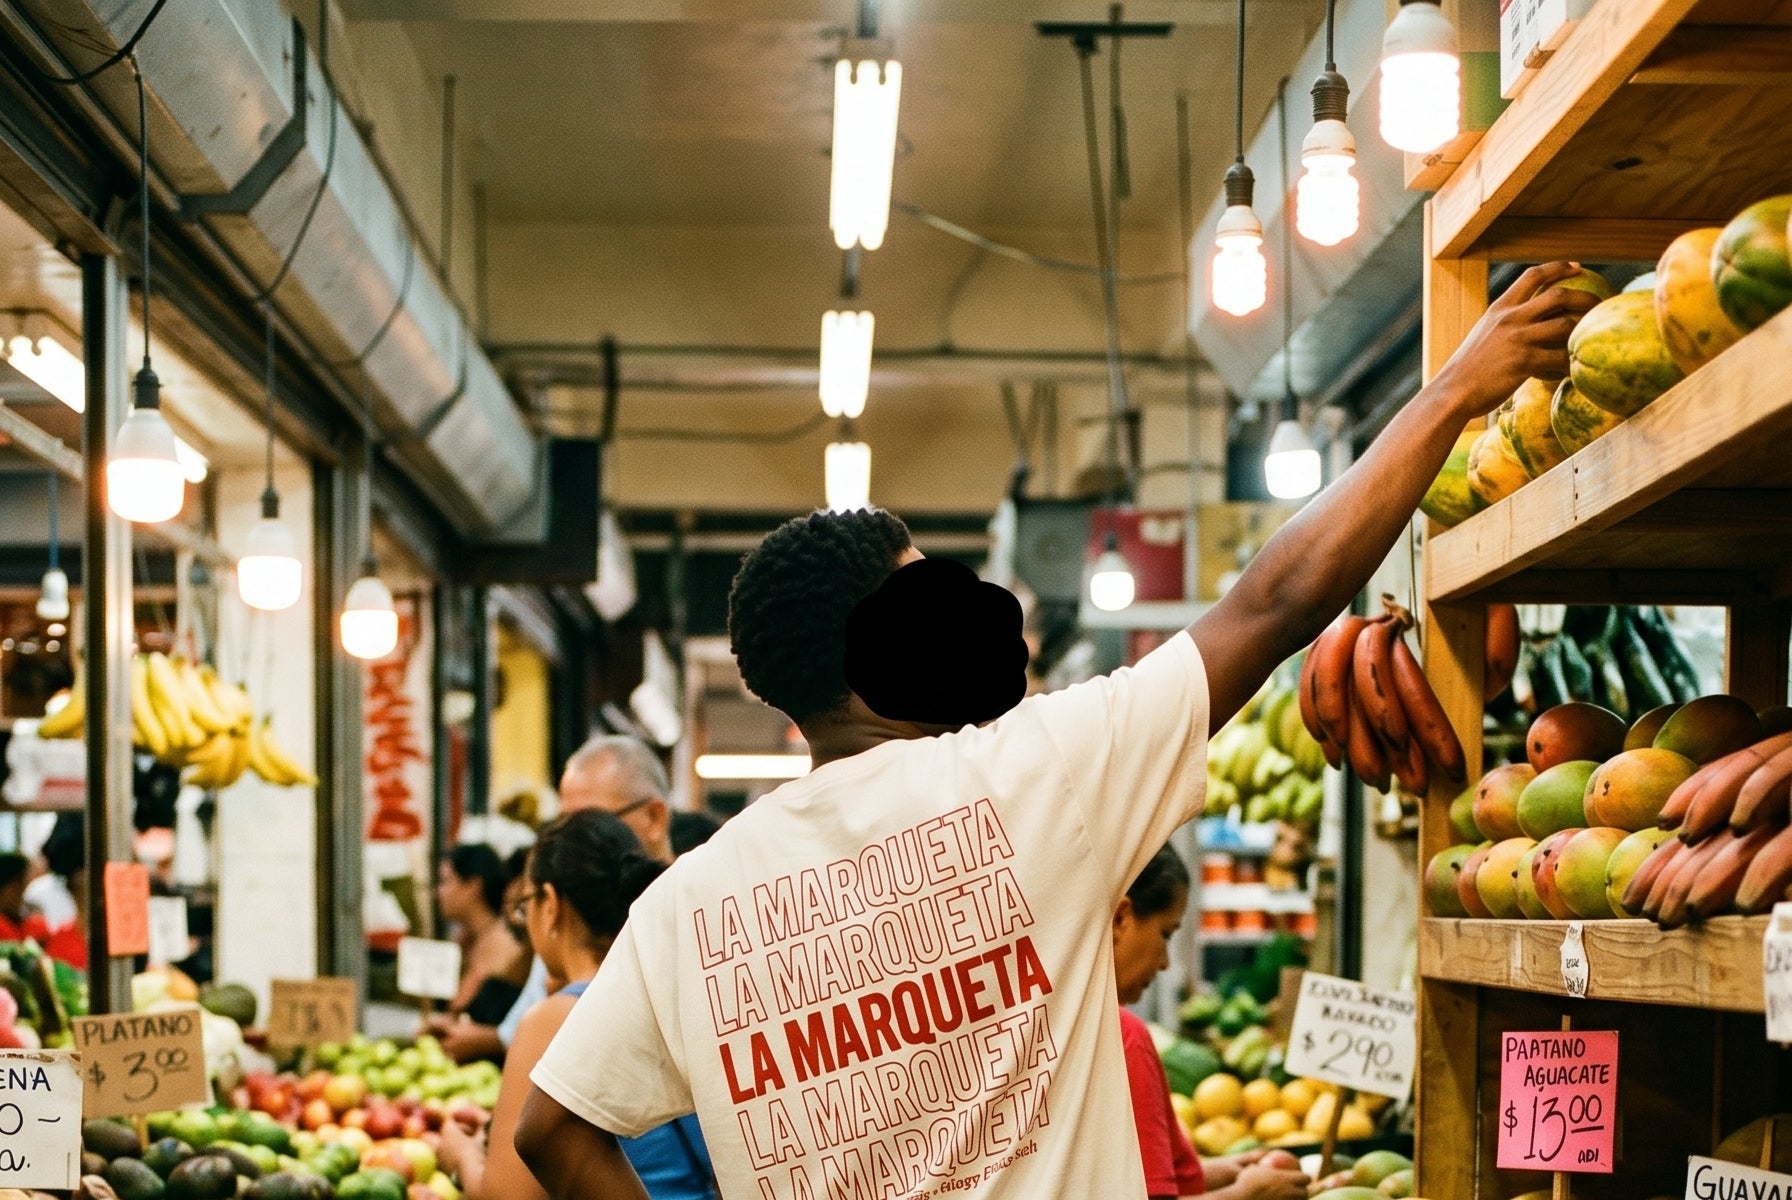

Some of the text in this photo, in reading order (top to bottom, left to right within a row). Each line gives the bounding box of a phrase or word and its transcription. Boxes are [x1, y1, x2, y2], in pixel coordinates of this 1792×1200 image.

[693, 798, 1015, 970] LA MARQUETA
[705, 867, 1035, 1037] LA MARQUETA
[82, 1014, 193, 1047] PLATANO
[719, 936, 1053, 1105] LA MARQUETA
[88, 1059, 106, 1090] $
[737, 1003, 1058, 1171] LA MARQUETA
[1503, 1100, 1518, 1137] $
[1523, 1063, 1610, 1090] AGUACATE
